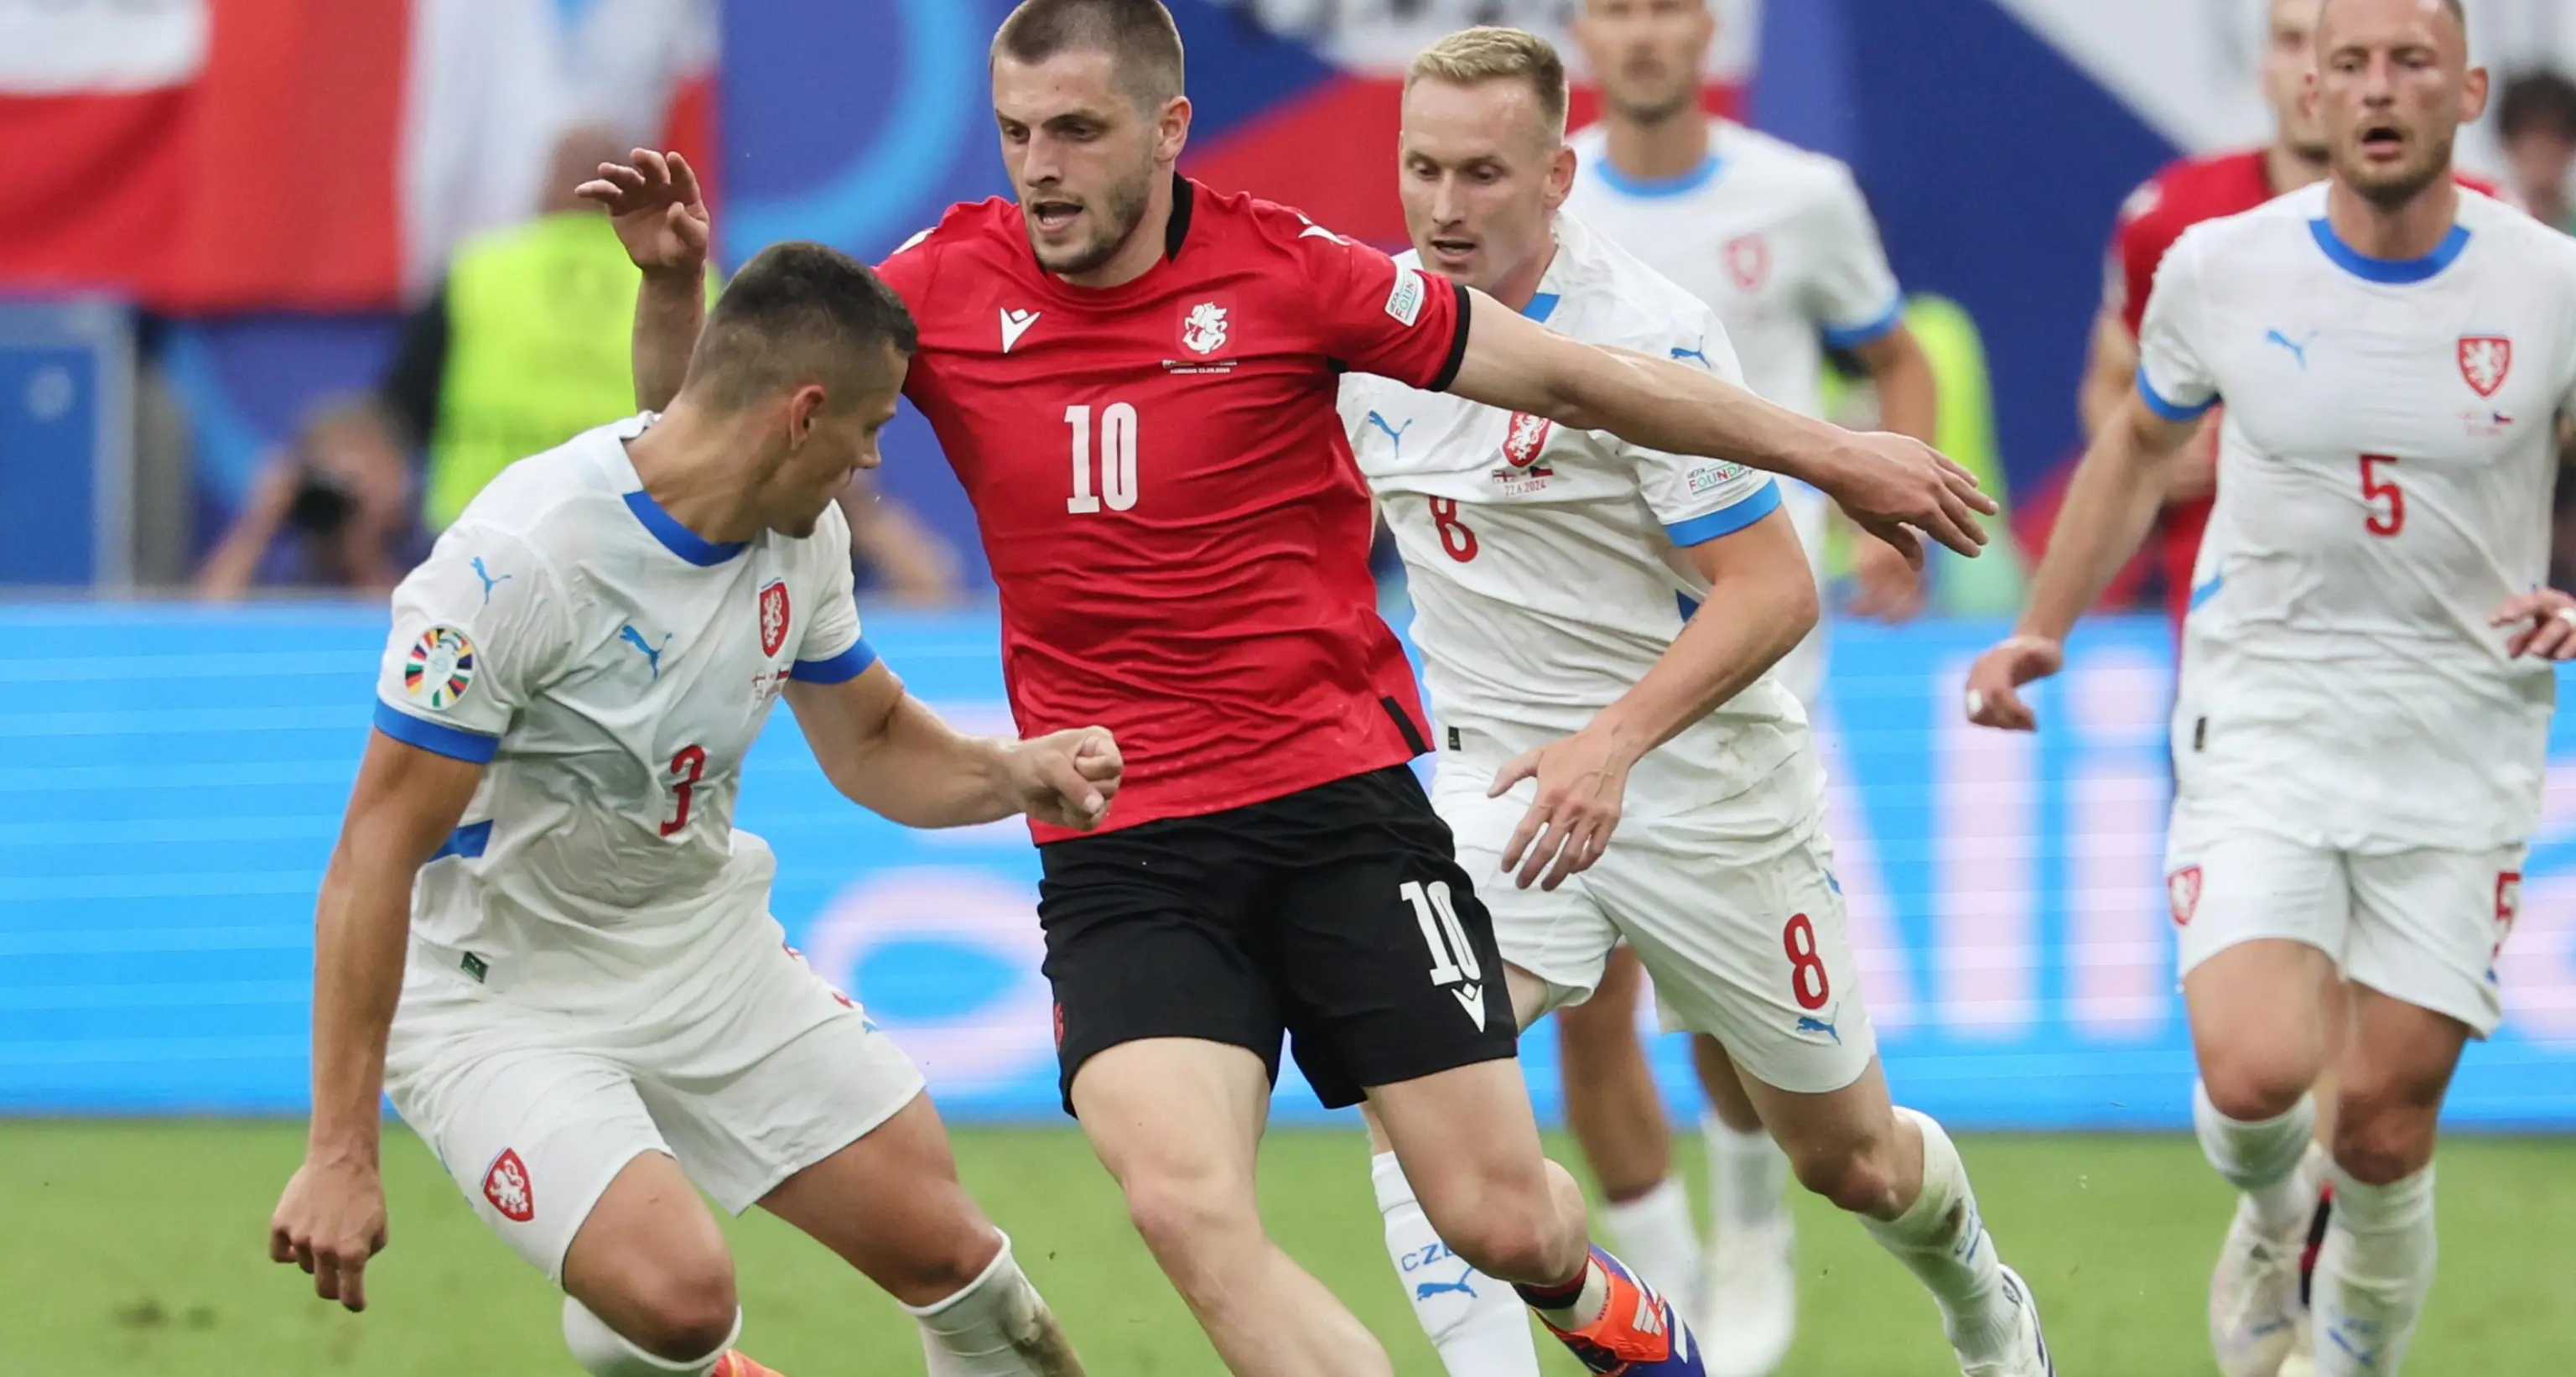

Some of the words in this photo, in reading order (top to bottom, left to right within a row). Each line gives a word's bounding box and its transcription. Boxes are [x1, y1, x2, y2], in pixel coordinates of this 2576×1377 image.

[1063, 402, 1138, 514] 10
[2357, 453, 2404, 537] 5
[1429, 494, 1479, 564] 8
[659, 742, 707, 838] 3
[1399, 881, 1481, 986] 10
[1783, 912, 1830, 1011] 8
